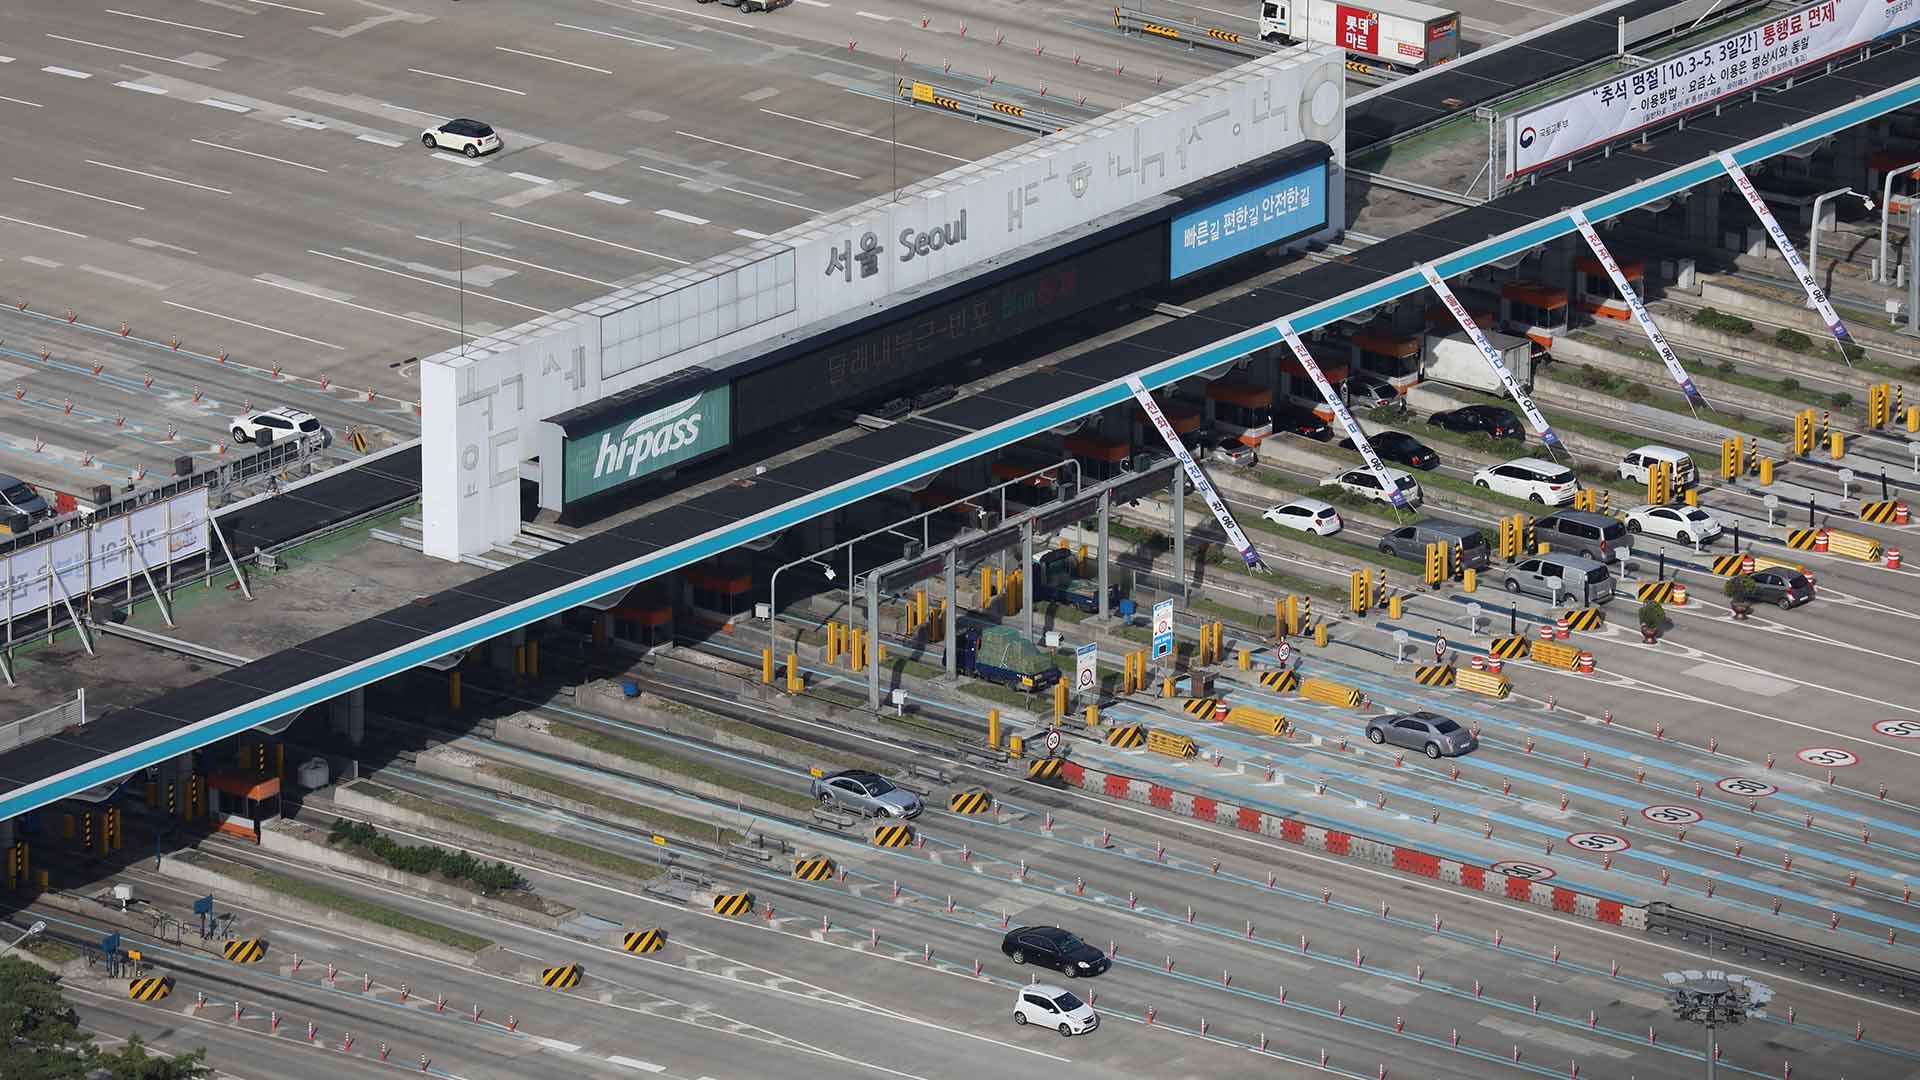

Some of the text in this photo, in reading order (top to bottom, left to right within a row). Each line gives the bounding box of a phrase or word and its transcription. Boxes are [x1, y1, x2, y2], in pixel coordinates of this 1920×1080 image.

[1345, 15, 1370, 36] 롯데
[1345, 36, 1369, 51] 마트
[1632, 68, 1659, 96] 명절
[1720, 31, 1758, 62] 3일간]
[1762, 15, 1804, 48] 통행료
[1640, 86, 1678, 112] 이용방법
[1688, 73, 1716, 93] 요금소
[1720, 60, 1748, 81] 이용은
[1751, 45, 1788, 70] 평상시와
[1791, 36, 1810, 55] 동일
[899, 208, 967, 262] Seoul
[1184, 185, 1310, 249] 빠른길 편한길 안전한길
[825, 231, 884, 283] 서울
[1803, 275, 1832, 316] 착용!
[1652, 333, 1682, 374] 착용!
[1505, 373, 1542, 424] 가세요!
[593, 411, 703, 479] hi-pass
[1360, 443, 1391, 484] 착용!
[1211, 500, 1242, 542] 착용!
[1884, 721, 1920, 736] 30
[1809, 750, 1849, 765] 30
[1728, 779, 1768, 794] 30
[1652, 807, 1692, 822] 30
[1578, 835, 1618, 850] 30
[1503, 864, 1542, 879] 30
